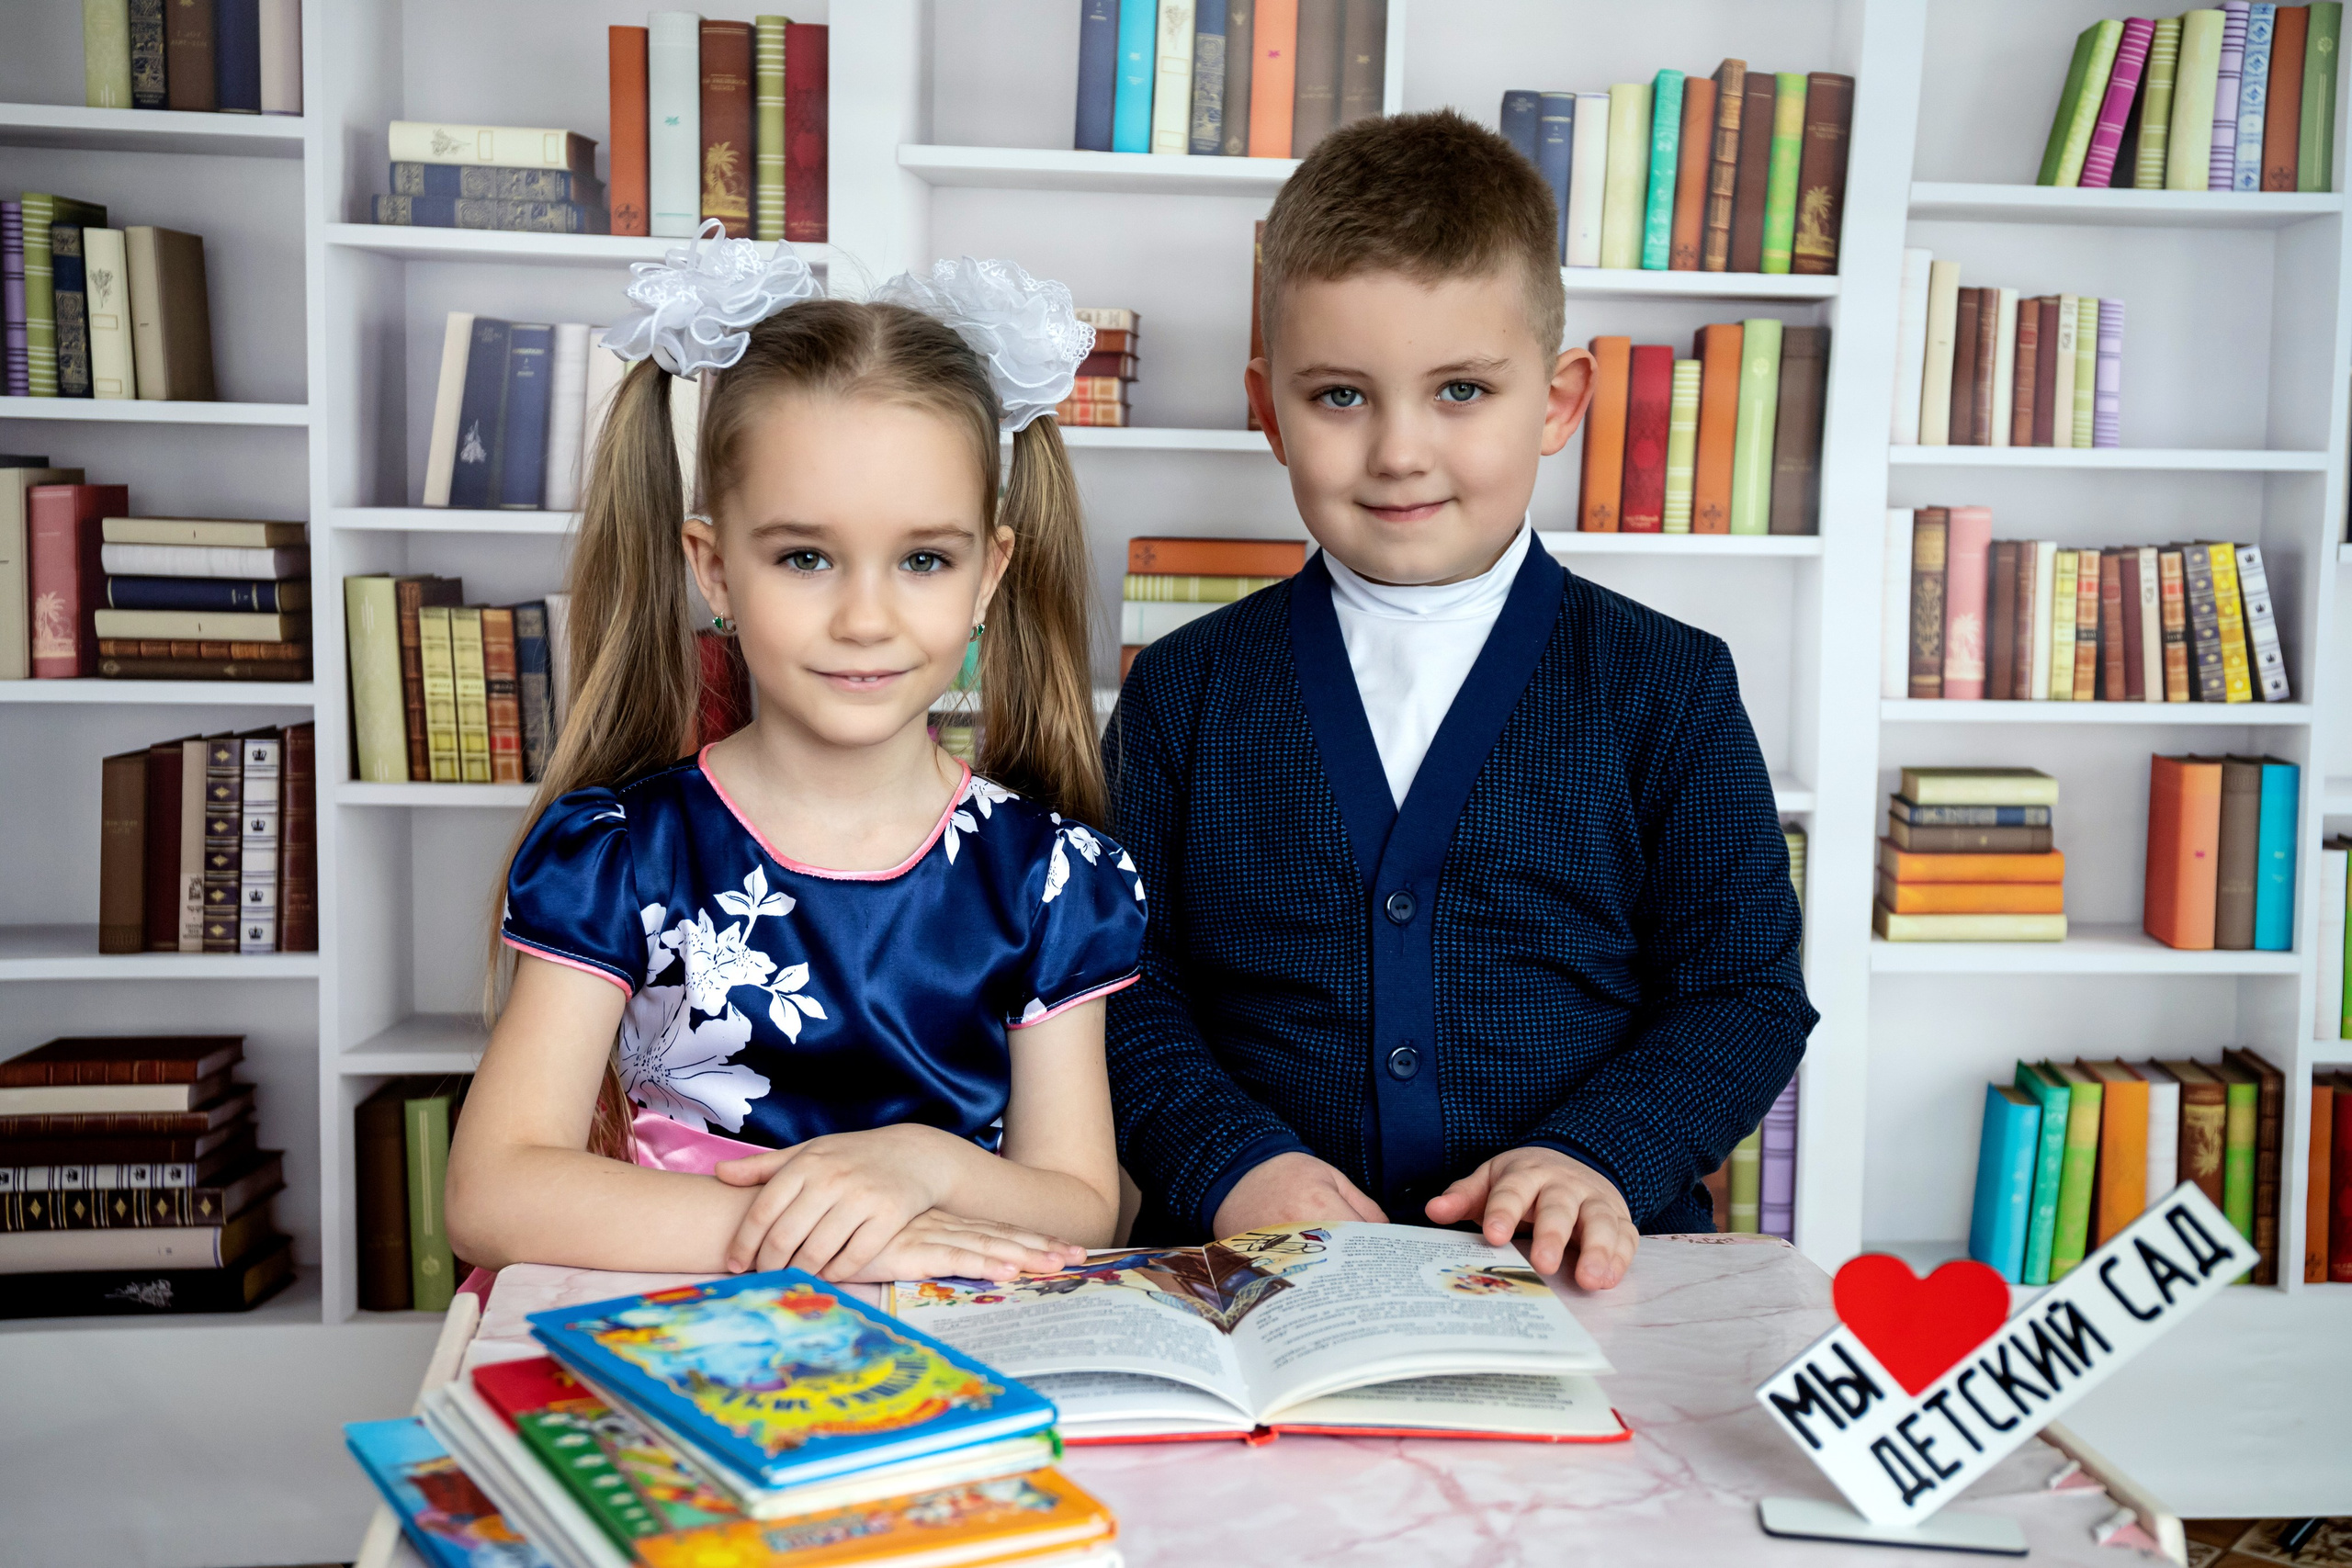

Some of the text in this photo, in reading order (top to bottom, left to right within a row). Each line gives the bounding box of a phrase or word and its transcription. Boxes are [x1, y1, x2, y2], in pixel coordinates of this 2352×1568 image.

[1768, 1342, 1884, 1450] МЫ
[1869, 1203, 2235, 1507] ДЕТСКИЙ САД
